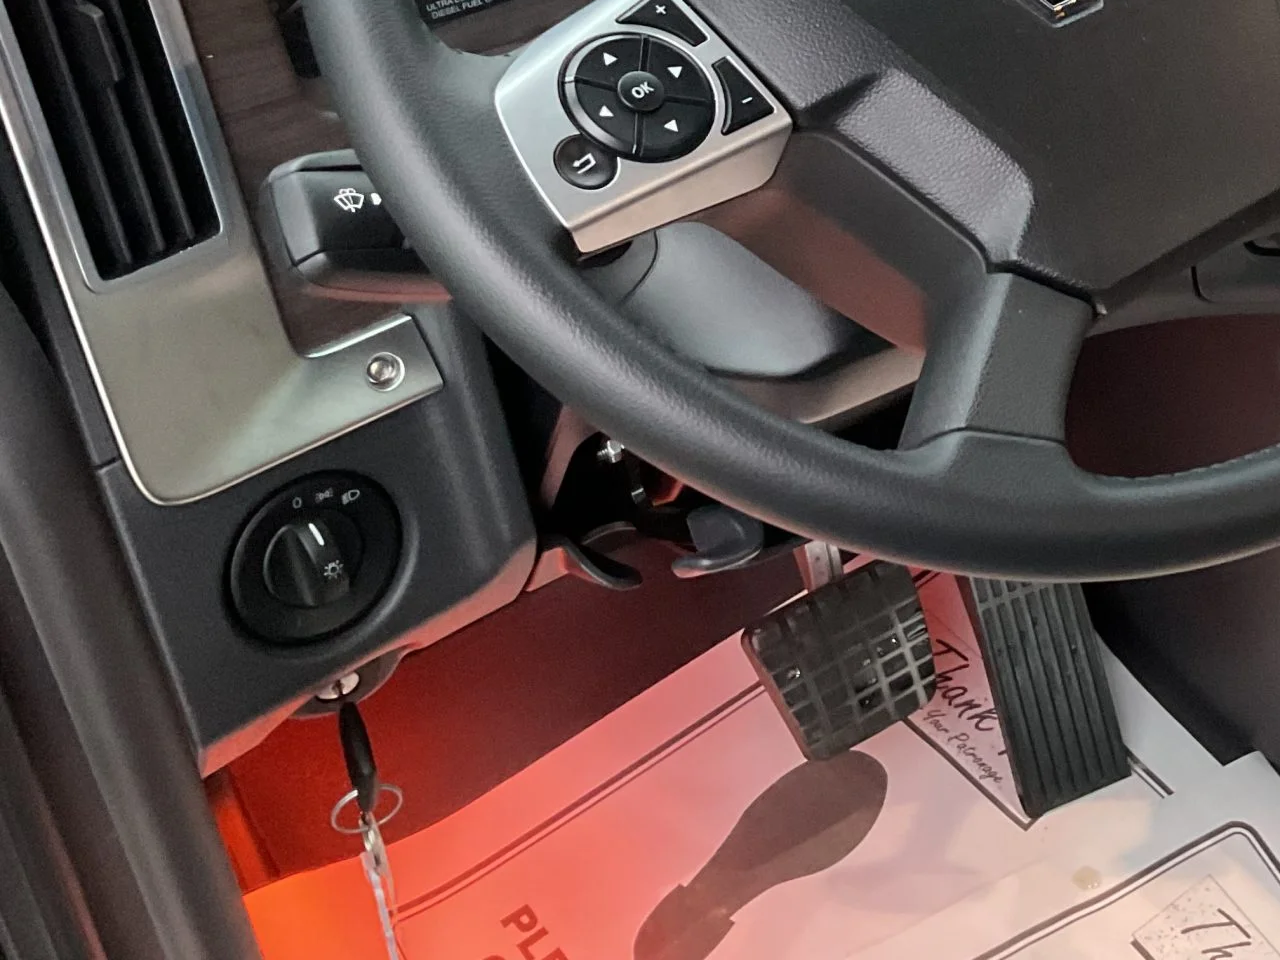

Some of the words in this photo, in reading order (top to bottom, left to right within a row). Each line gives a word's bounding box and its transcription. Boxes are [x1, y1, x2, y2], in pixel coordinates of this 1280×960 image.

[431, 5, 460, 20] DIESEL
[461, 0, 482, 11] FUEL
[631, 81, 655, 99] OK
[932, 638, 1000, 733] Thank
